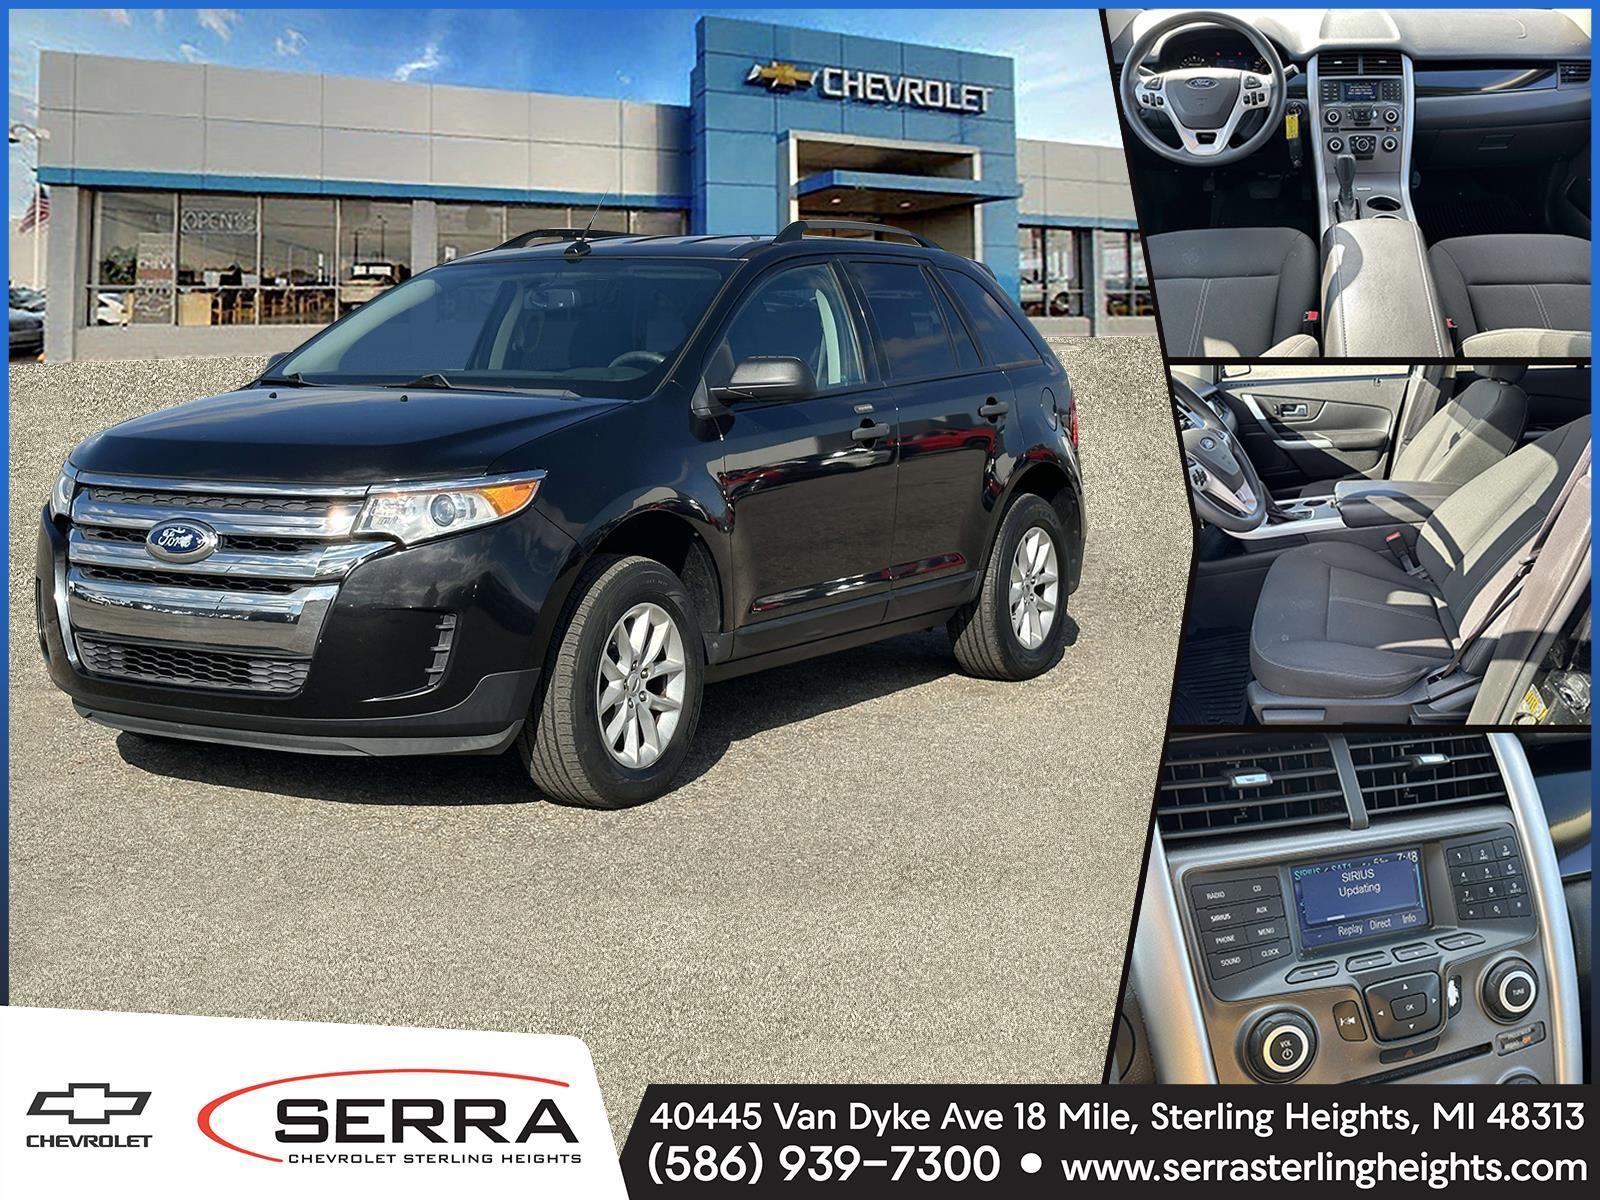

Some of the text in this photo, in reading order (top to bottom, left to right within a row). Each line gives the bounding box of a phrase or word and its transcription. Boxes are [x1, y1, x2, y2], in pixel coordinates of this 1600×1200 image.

[822, 66, 993, 112] CHEVROLET
[158, 527, 193, 548] Ford
[1341, 868, 1375, 883] SIRIUS
[1338, 882, 1381, 898] Updating
[1206, 891, 1226, 900] RADIO
[1256, 906, 1268, 914] AUX
[1210, 912, 1231, 922] SIRIUS
[1338, 913, 1416, 936] Replay Direct Info
[1257, 927, 1275, 936] MENU
[1215, 934, 1236, 944] PHONE
[1261, 948, 1280, 957] CLOCK
[1220, 957, 1241, 967] SOUND
[1512, 987, 1525, 996] TUNE
[1405, 1003, 1415, 1012] OK
[1280, 1040, 1293, 1048] VOL
